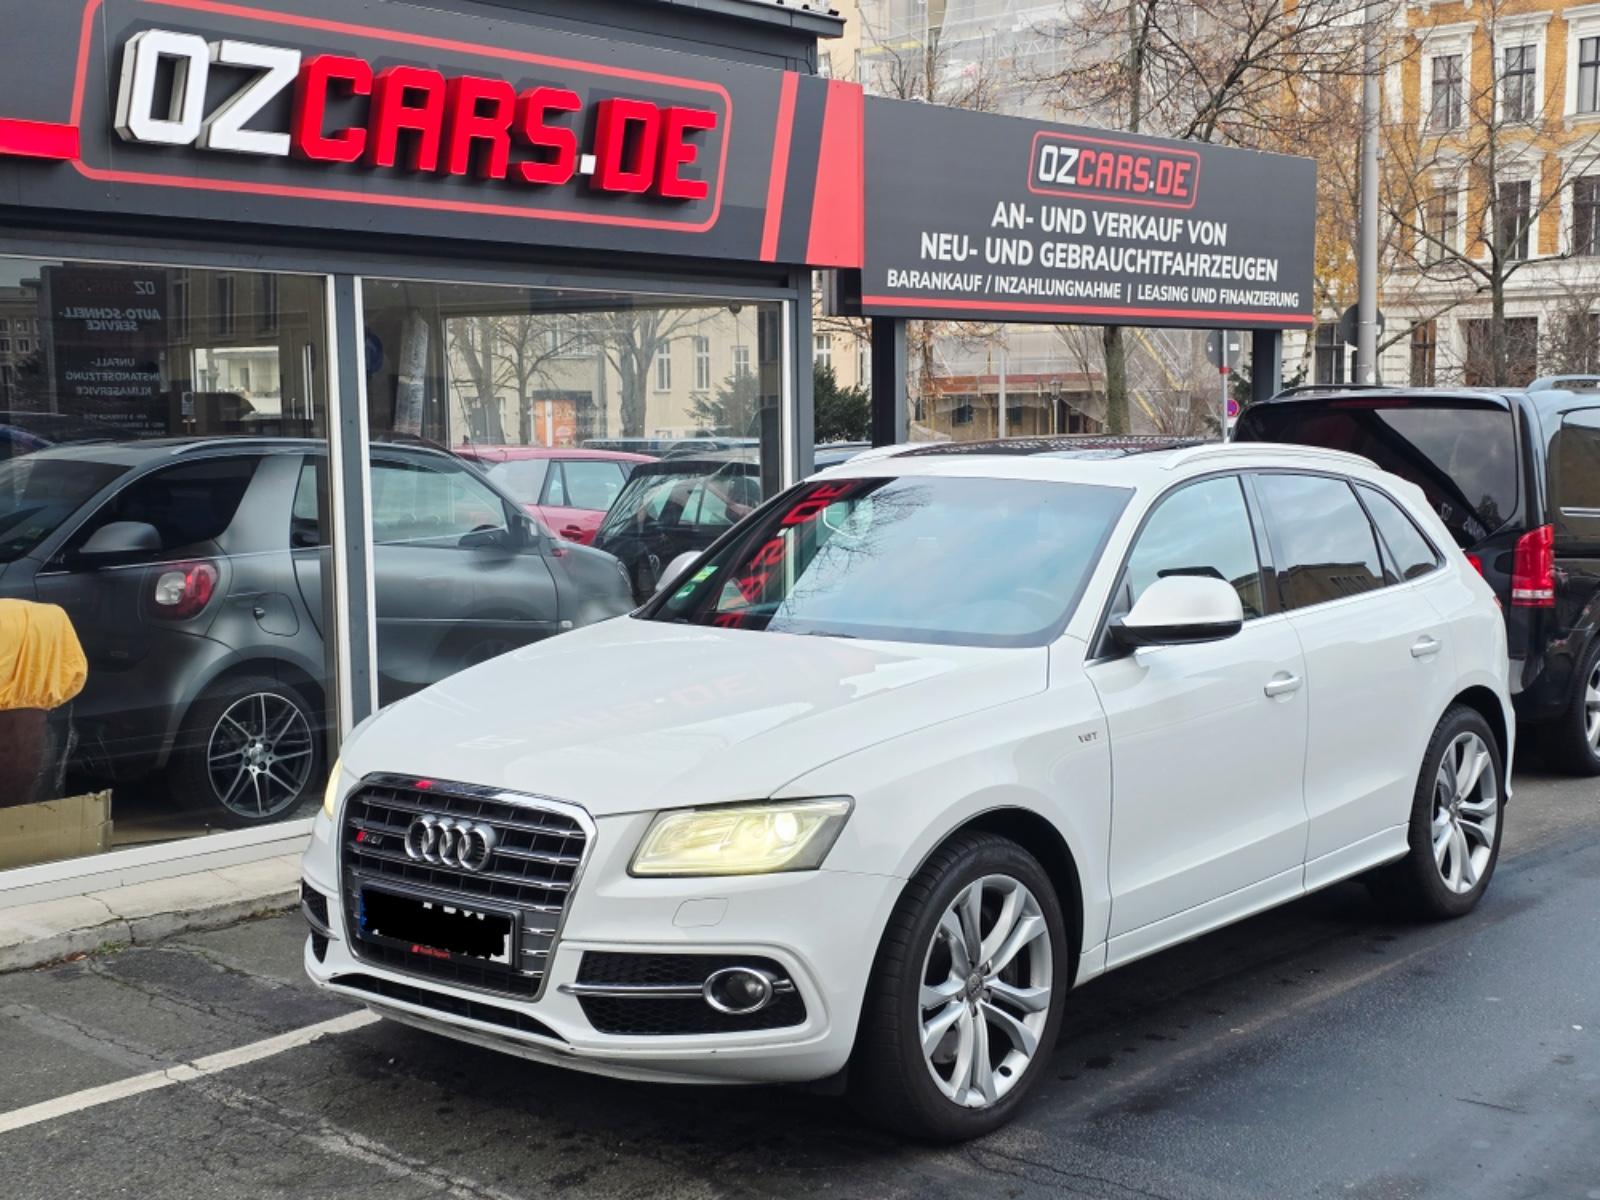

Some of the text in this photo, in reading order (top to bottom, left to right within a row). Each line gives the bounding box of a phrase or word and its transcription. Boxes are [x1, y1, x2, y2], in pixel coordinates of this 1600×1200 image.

[113, 28, 717, 200] OZCARS.DE
[1038, 144, 1191, 197] OZCARS.DE
[991, 201, 1227, 247] AN- UND VERKAUF VON
[920, 232, 1278, 282] NEU- UND GEBRAUCHTFAHRZEUGEN
[887, 269, 983, 292] BARANKAUF
[995, 276, 1121, 299] INZAHLUNGNAHME
[1137, 284, 1188, 303] LEASING
[1192, 288, 1216, 304] UND
[1219, 289, 1299, 307] FINANZIERUNG
